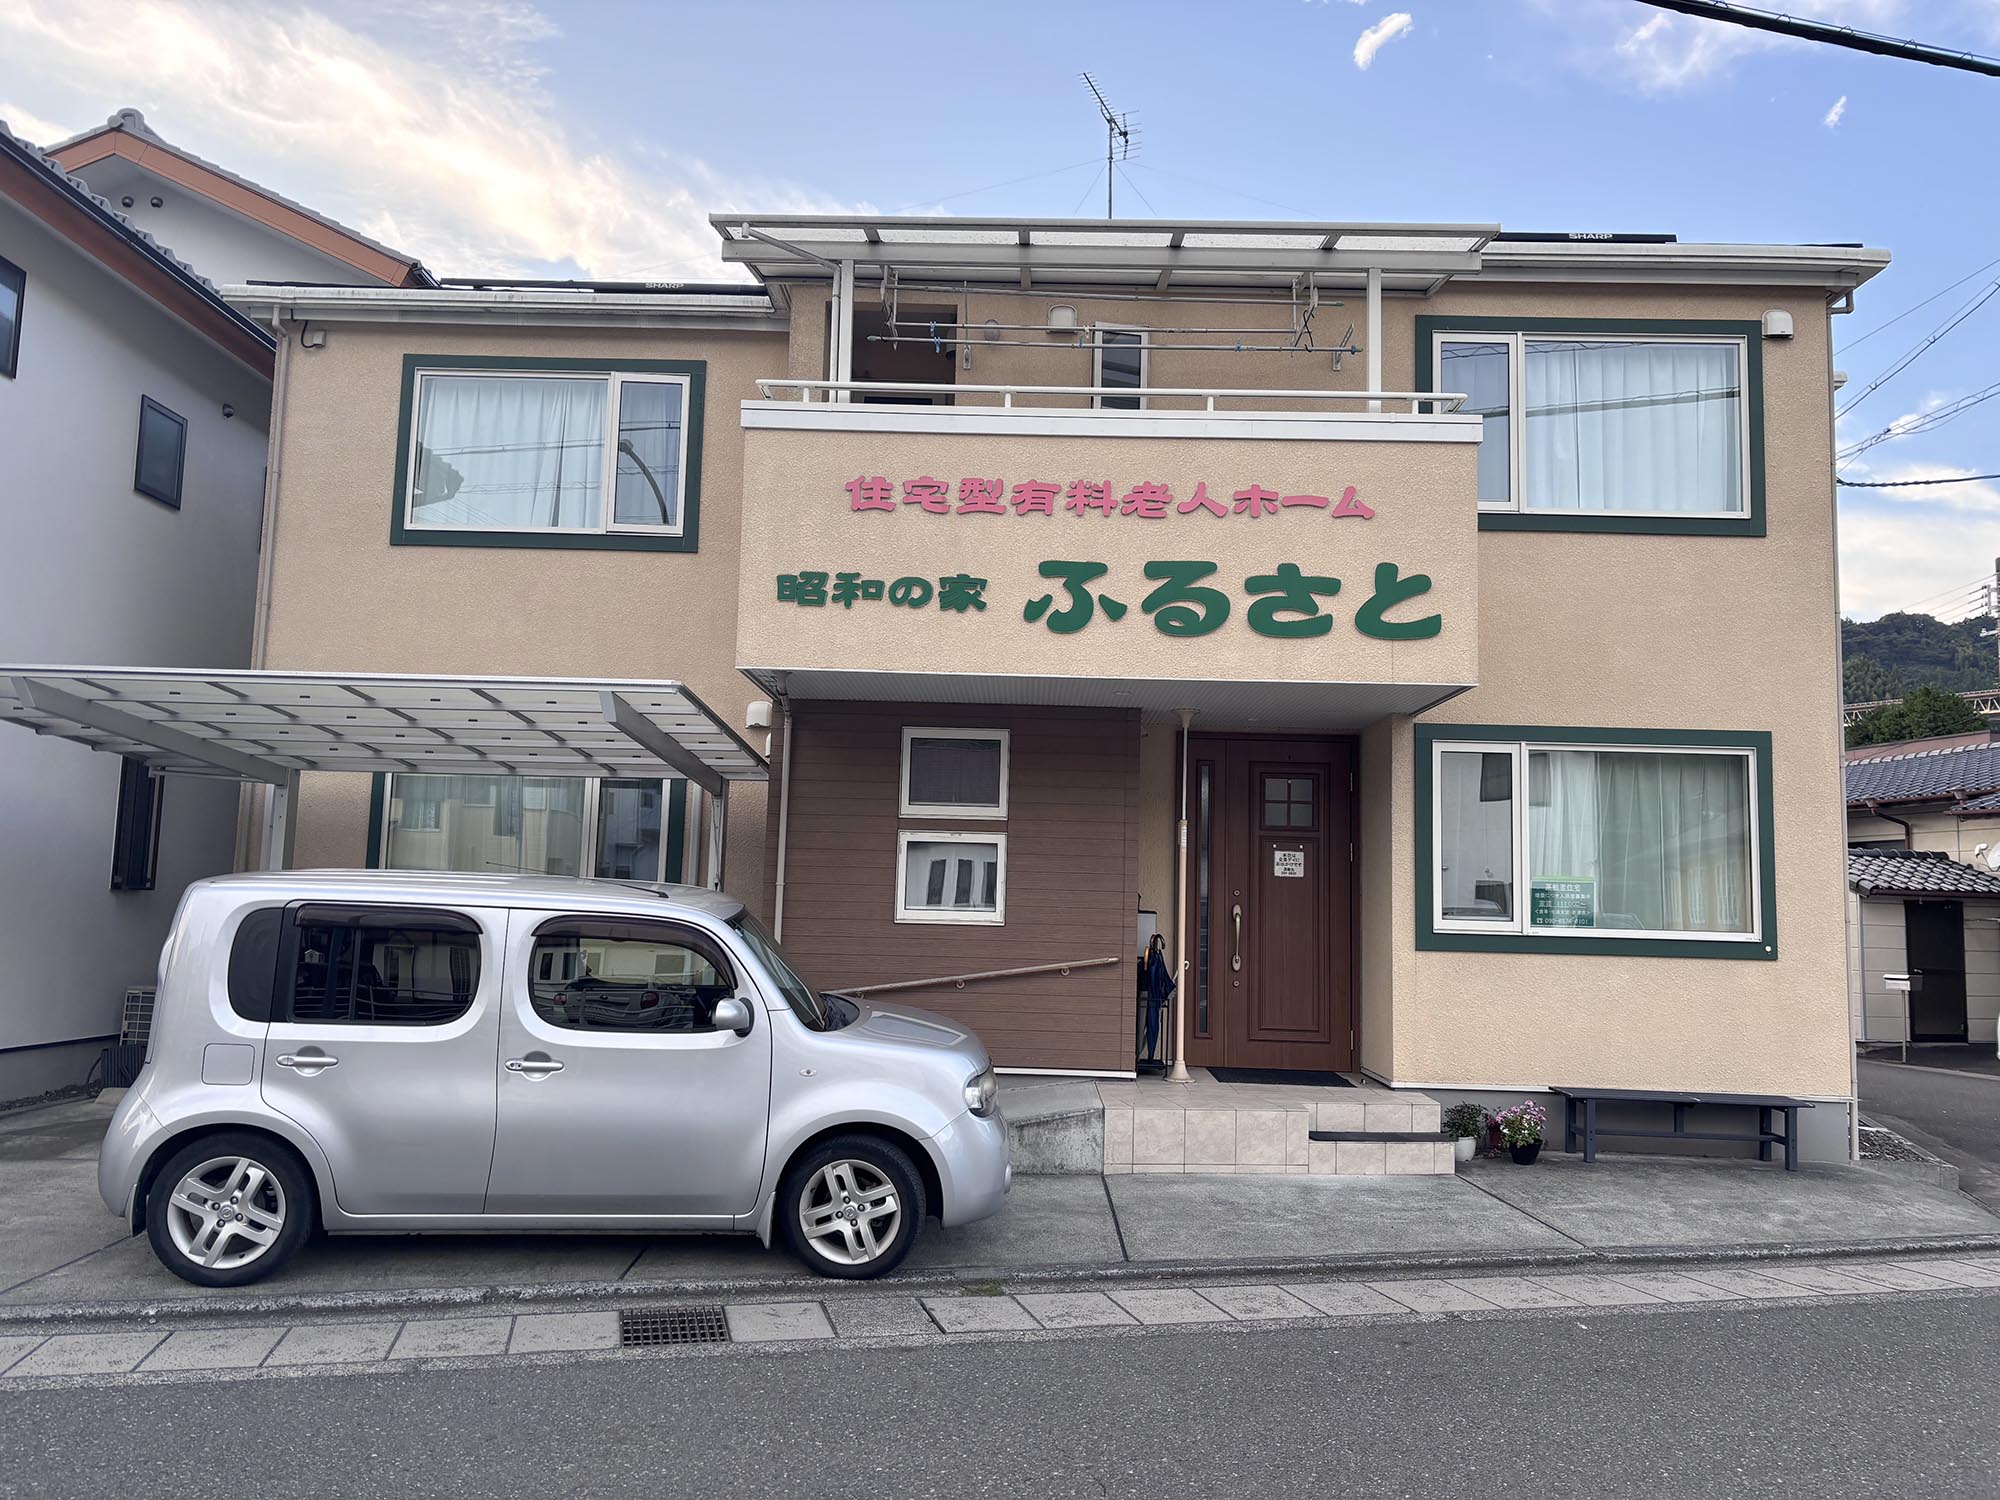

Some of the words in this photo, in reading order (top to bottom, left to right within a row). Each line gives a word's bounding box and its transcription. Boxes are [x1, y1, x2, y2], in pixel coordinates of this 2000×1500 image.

[1568, 232, 1613, 240] SHARP
[846, 476, 1375, 519] 住宅型有料老人ホーム
[777, 572, 987, 613] 昭和の家
[1023, 560, 1442, 640] ふるさと
